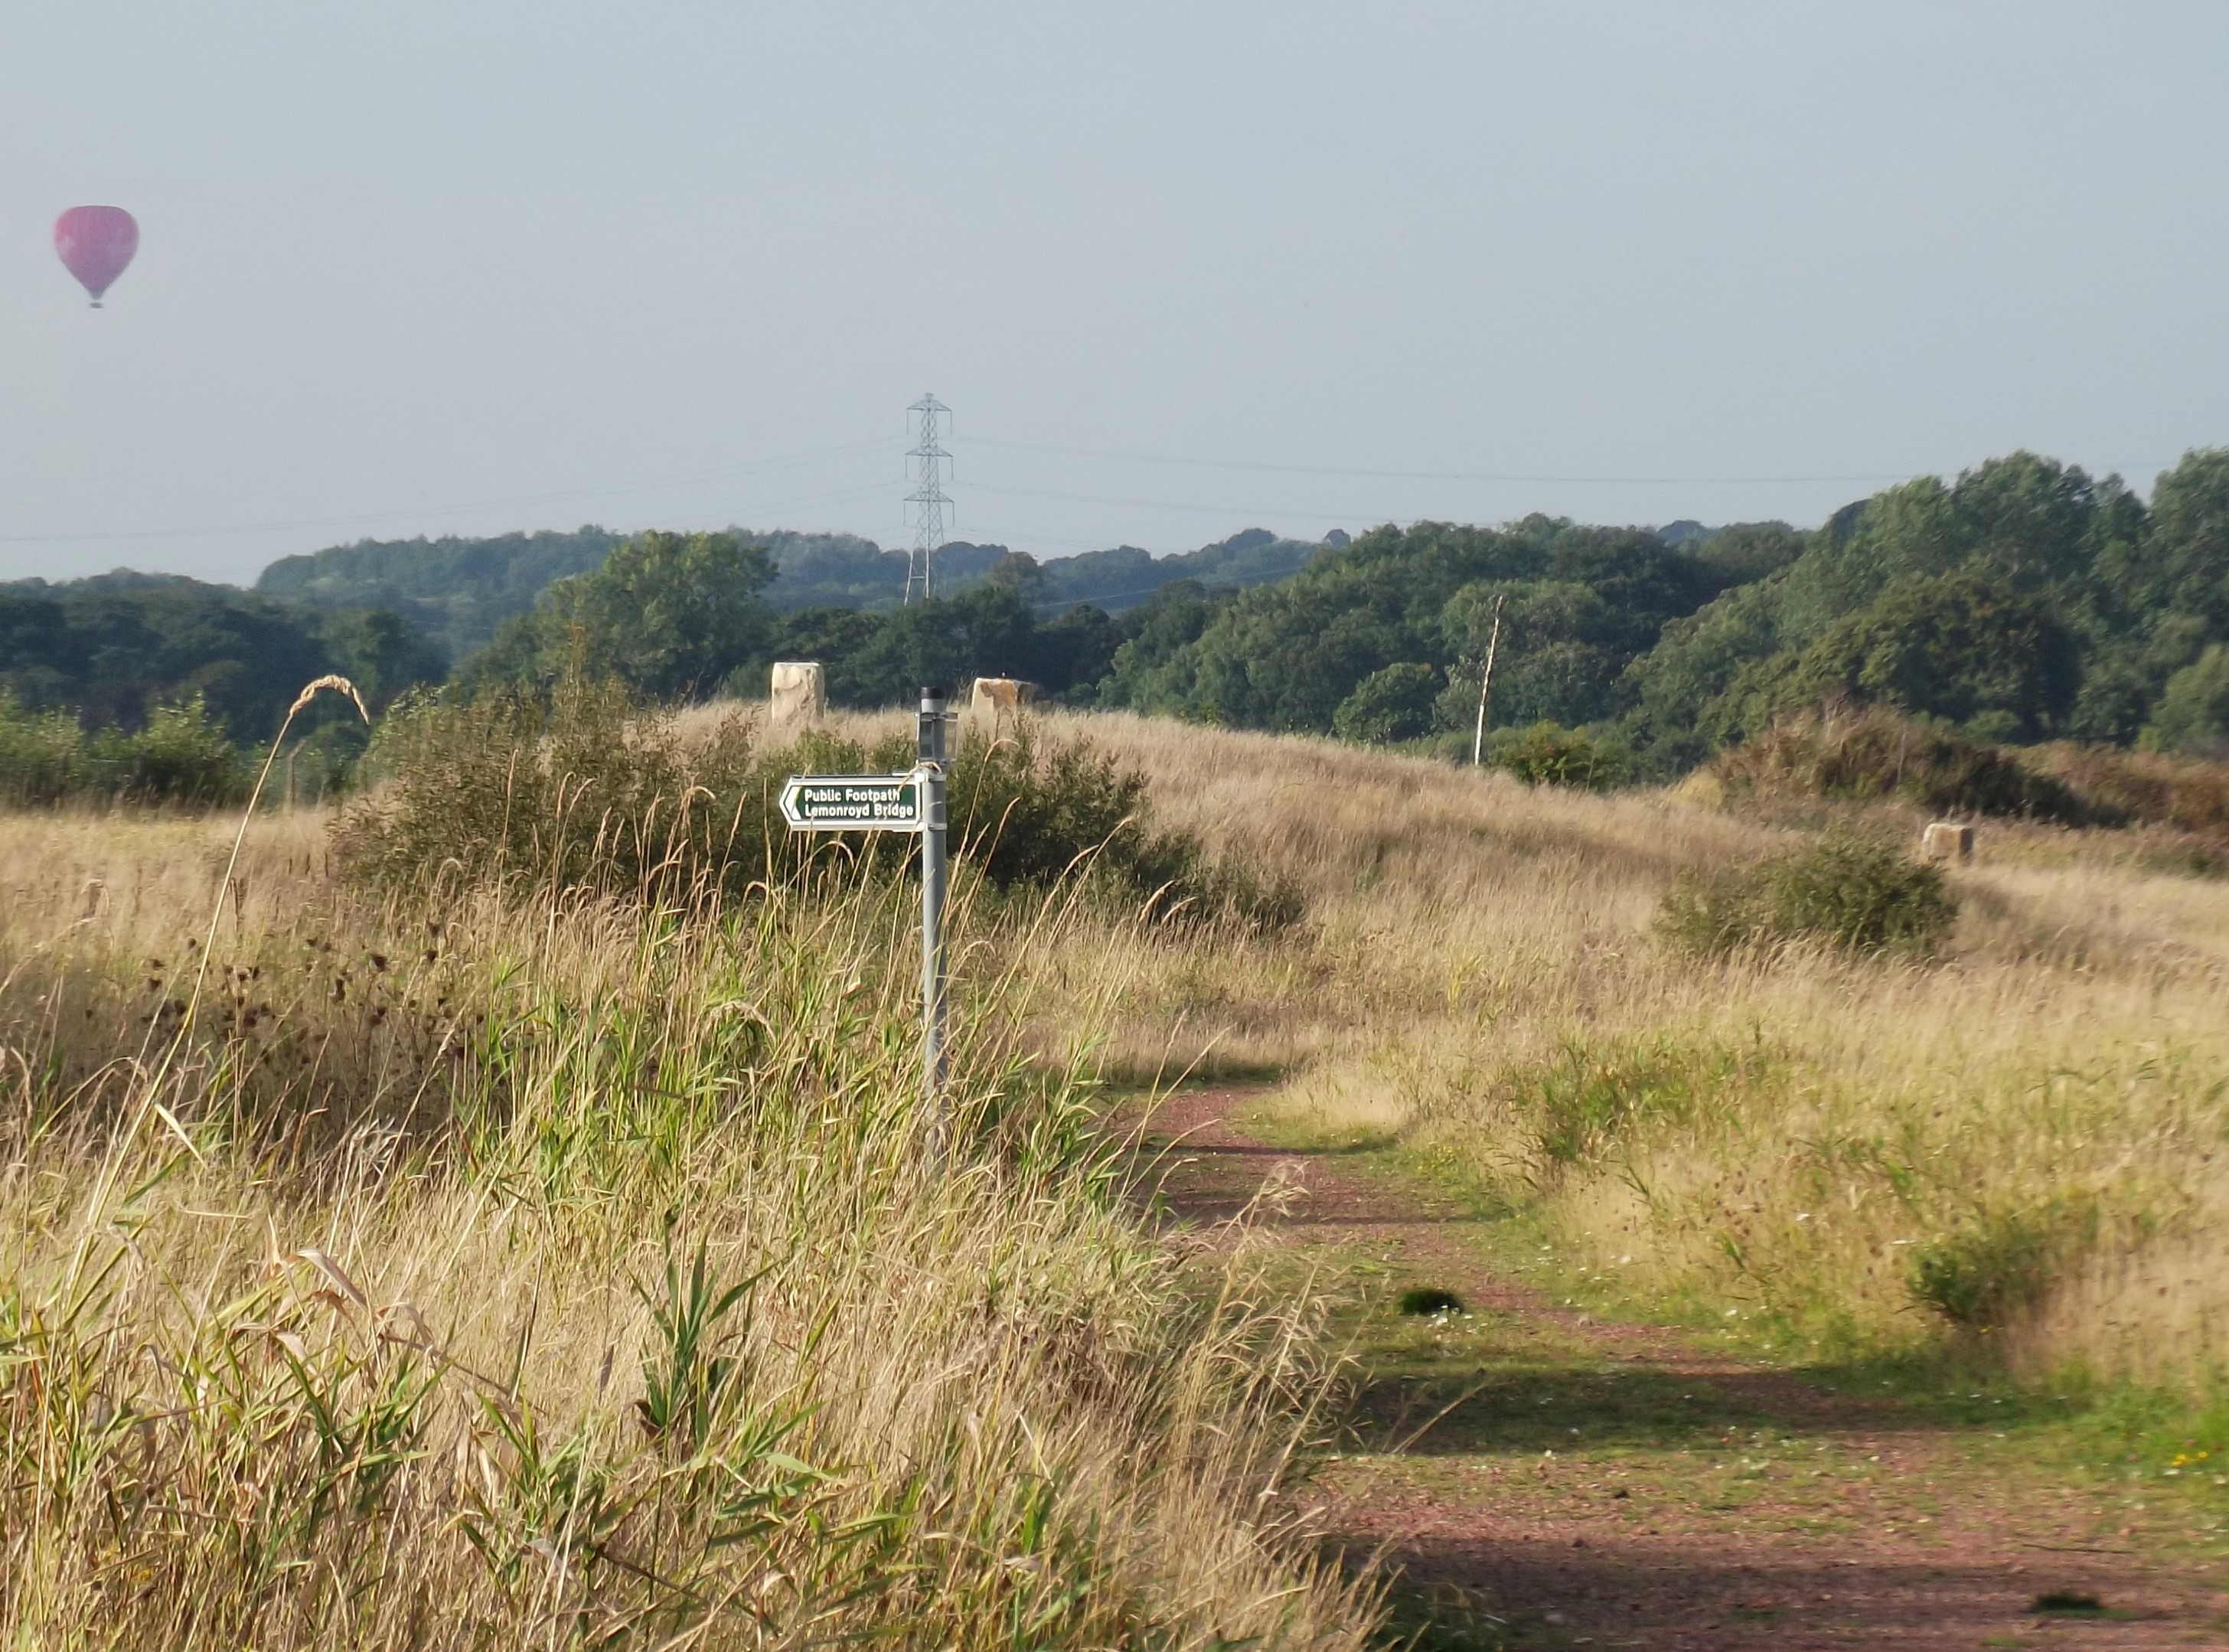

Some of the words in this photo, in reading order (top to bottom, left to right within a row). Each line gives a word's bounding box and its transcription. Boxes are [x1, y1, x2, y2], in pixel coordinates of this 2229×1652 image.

[804, 789, 841, 802] Public
[846, 789, 900, 803] Footpath
[804, 804, 870, 818] Lemonroyd
[874, 804, 914, 818] Bridge
